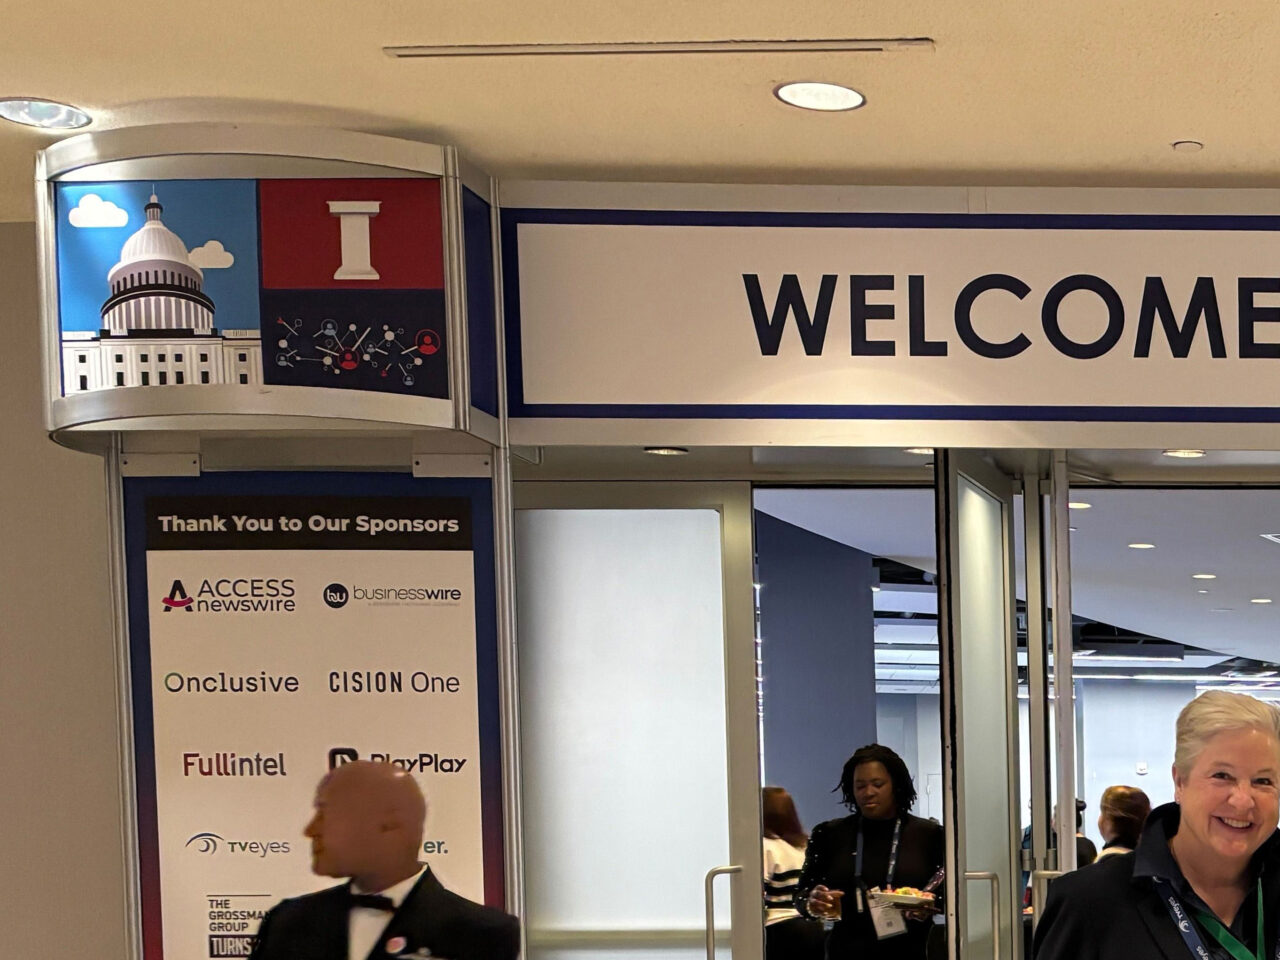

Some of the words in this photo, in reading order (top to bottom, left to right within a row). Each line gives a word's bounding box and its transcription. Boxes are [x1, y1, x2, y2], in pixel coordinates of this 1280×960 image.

[158, 515, 227, 532] Thank
[231, 515, 274, 532] You
[279, 516, 303, 532] to
[308, 515, 350, 532] Our
[355, 515, 460, 536] Sponsors
[197, 578, 296, 598] ACCESS
[353, 585, 462, 600] businesswire
[197, 598, 296, 612] newswire
[164, 671, 299, 693] Onclusive
[329, 671, 402, 693] CISION
[411, 671, 460, 693] One
[183, 752, 287, 777] Fullintel
[208, 899, 231, 909] THE
[209, 922, 249, 932] GROUP
[211, 937, 252, 956] TURNS
